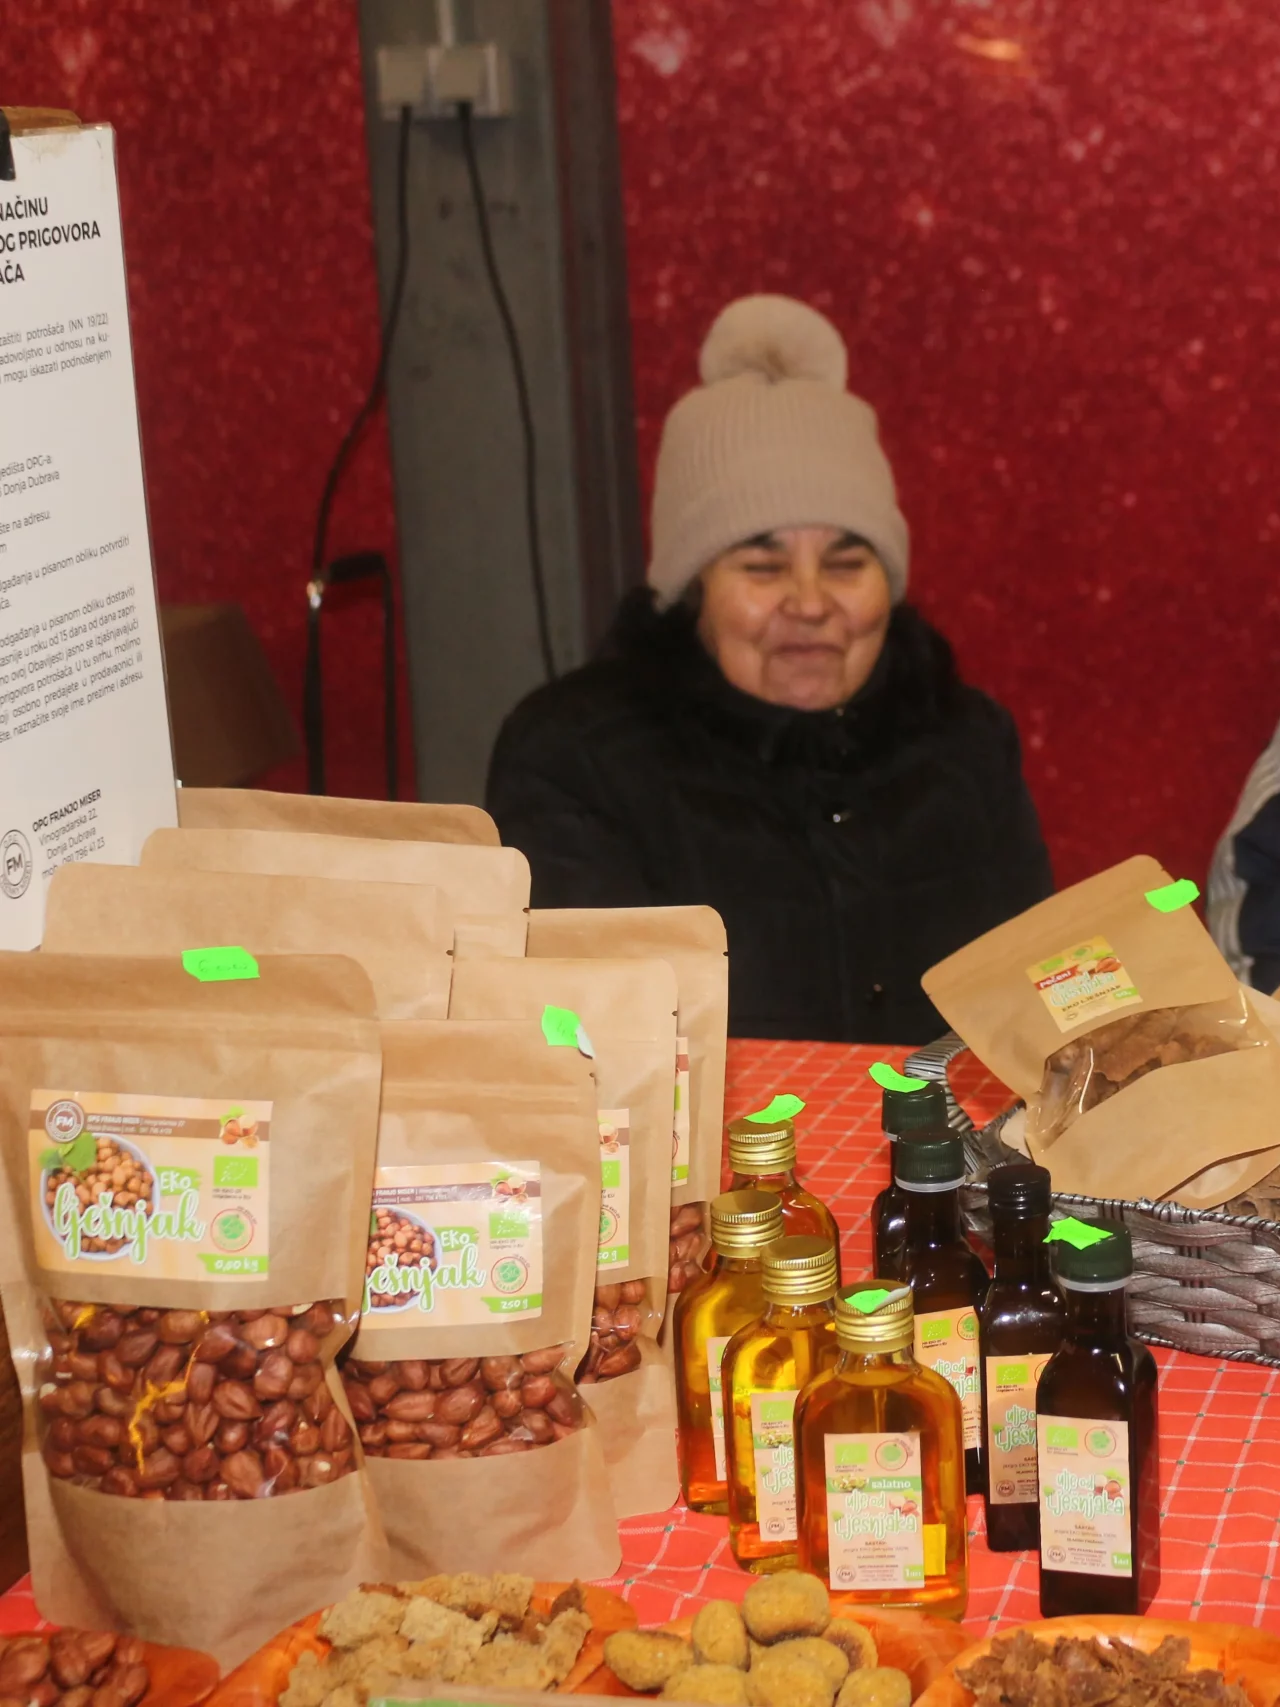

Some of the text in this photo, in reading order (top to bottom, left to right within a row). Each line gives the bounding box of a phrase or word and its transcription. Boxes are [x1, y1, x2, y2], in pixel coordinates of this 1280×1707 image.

[19, 220, 101, 250] PRIGOVORA
[26, 321, 65, 343] potrošača
[54, 339, 84, 353] odnosu
[86, 335, 96, 346] na
[3, 369, 28, 383] mogu
[61, 349, 112, 372] podnošenjem
[3, 470, 60, 496] Donja Dubrava
[12, 519, 22, 530] na
[41, 555, 74, 577] pisanom
[75, 547, 98, 564] obliku
[99, 534, 130, 557] potvrditi
[48, 607, 80, 631] pisanom
[82, 599, 104, 615] obliku
[105, 585, 135, 606] dostaviti
[79, 789, 101, 808] MISER
[56, 1115, 74, 1127] FM
[952, 1356, 966, 1375] od
[1028, 1410, 1036, 1421] o
[871, 1478, 911, 1489] salatno
